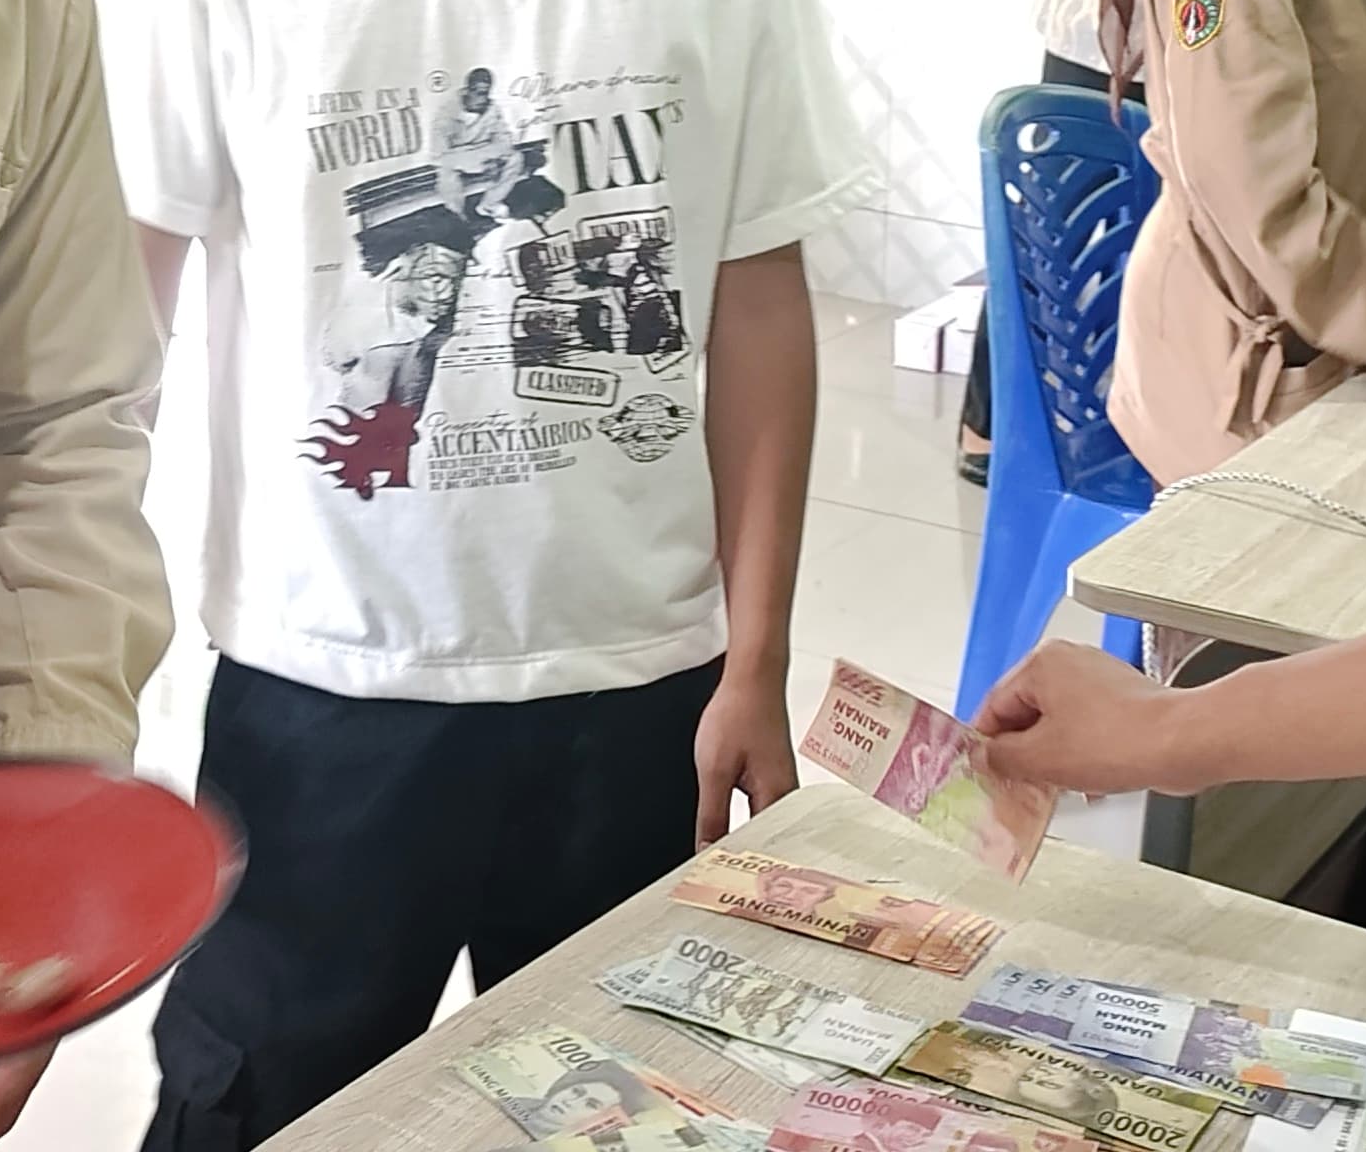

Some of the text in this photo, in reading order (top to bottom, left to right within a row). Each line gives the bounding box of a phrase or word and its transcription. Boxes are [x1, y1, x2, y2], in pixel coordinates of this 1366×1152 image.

[307, 105, 423, 174] WORLD
[527, 370, 608, 397] CLASSIFIED
[834, 720, 874, 754] UANG
[835, 698, 892, 741] MAINAN
[718, 892, 869, 939] UANG MAINAN
[678, 938, 746, 975] 2000
[1095, 991, 1164, 1015] 50000
[1095, 1009, 1168, 1032] MAINAN
[822, 1017, 895, 1041] MAINAN
[824, 1028, 875, 1048] UANG
[1101, 1021, 1154, 1040] UANG
[548, 1034, 600, 1073] 1000
[982, 1035, 1086, 1074] MAINAN
[468, 1063, 533, 1123] UANG MAINAN
[1091, 1068, 1164, 1099] UANG
[1096, 1108, 1190, 1150] 20000
